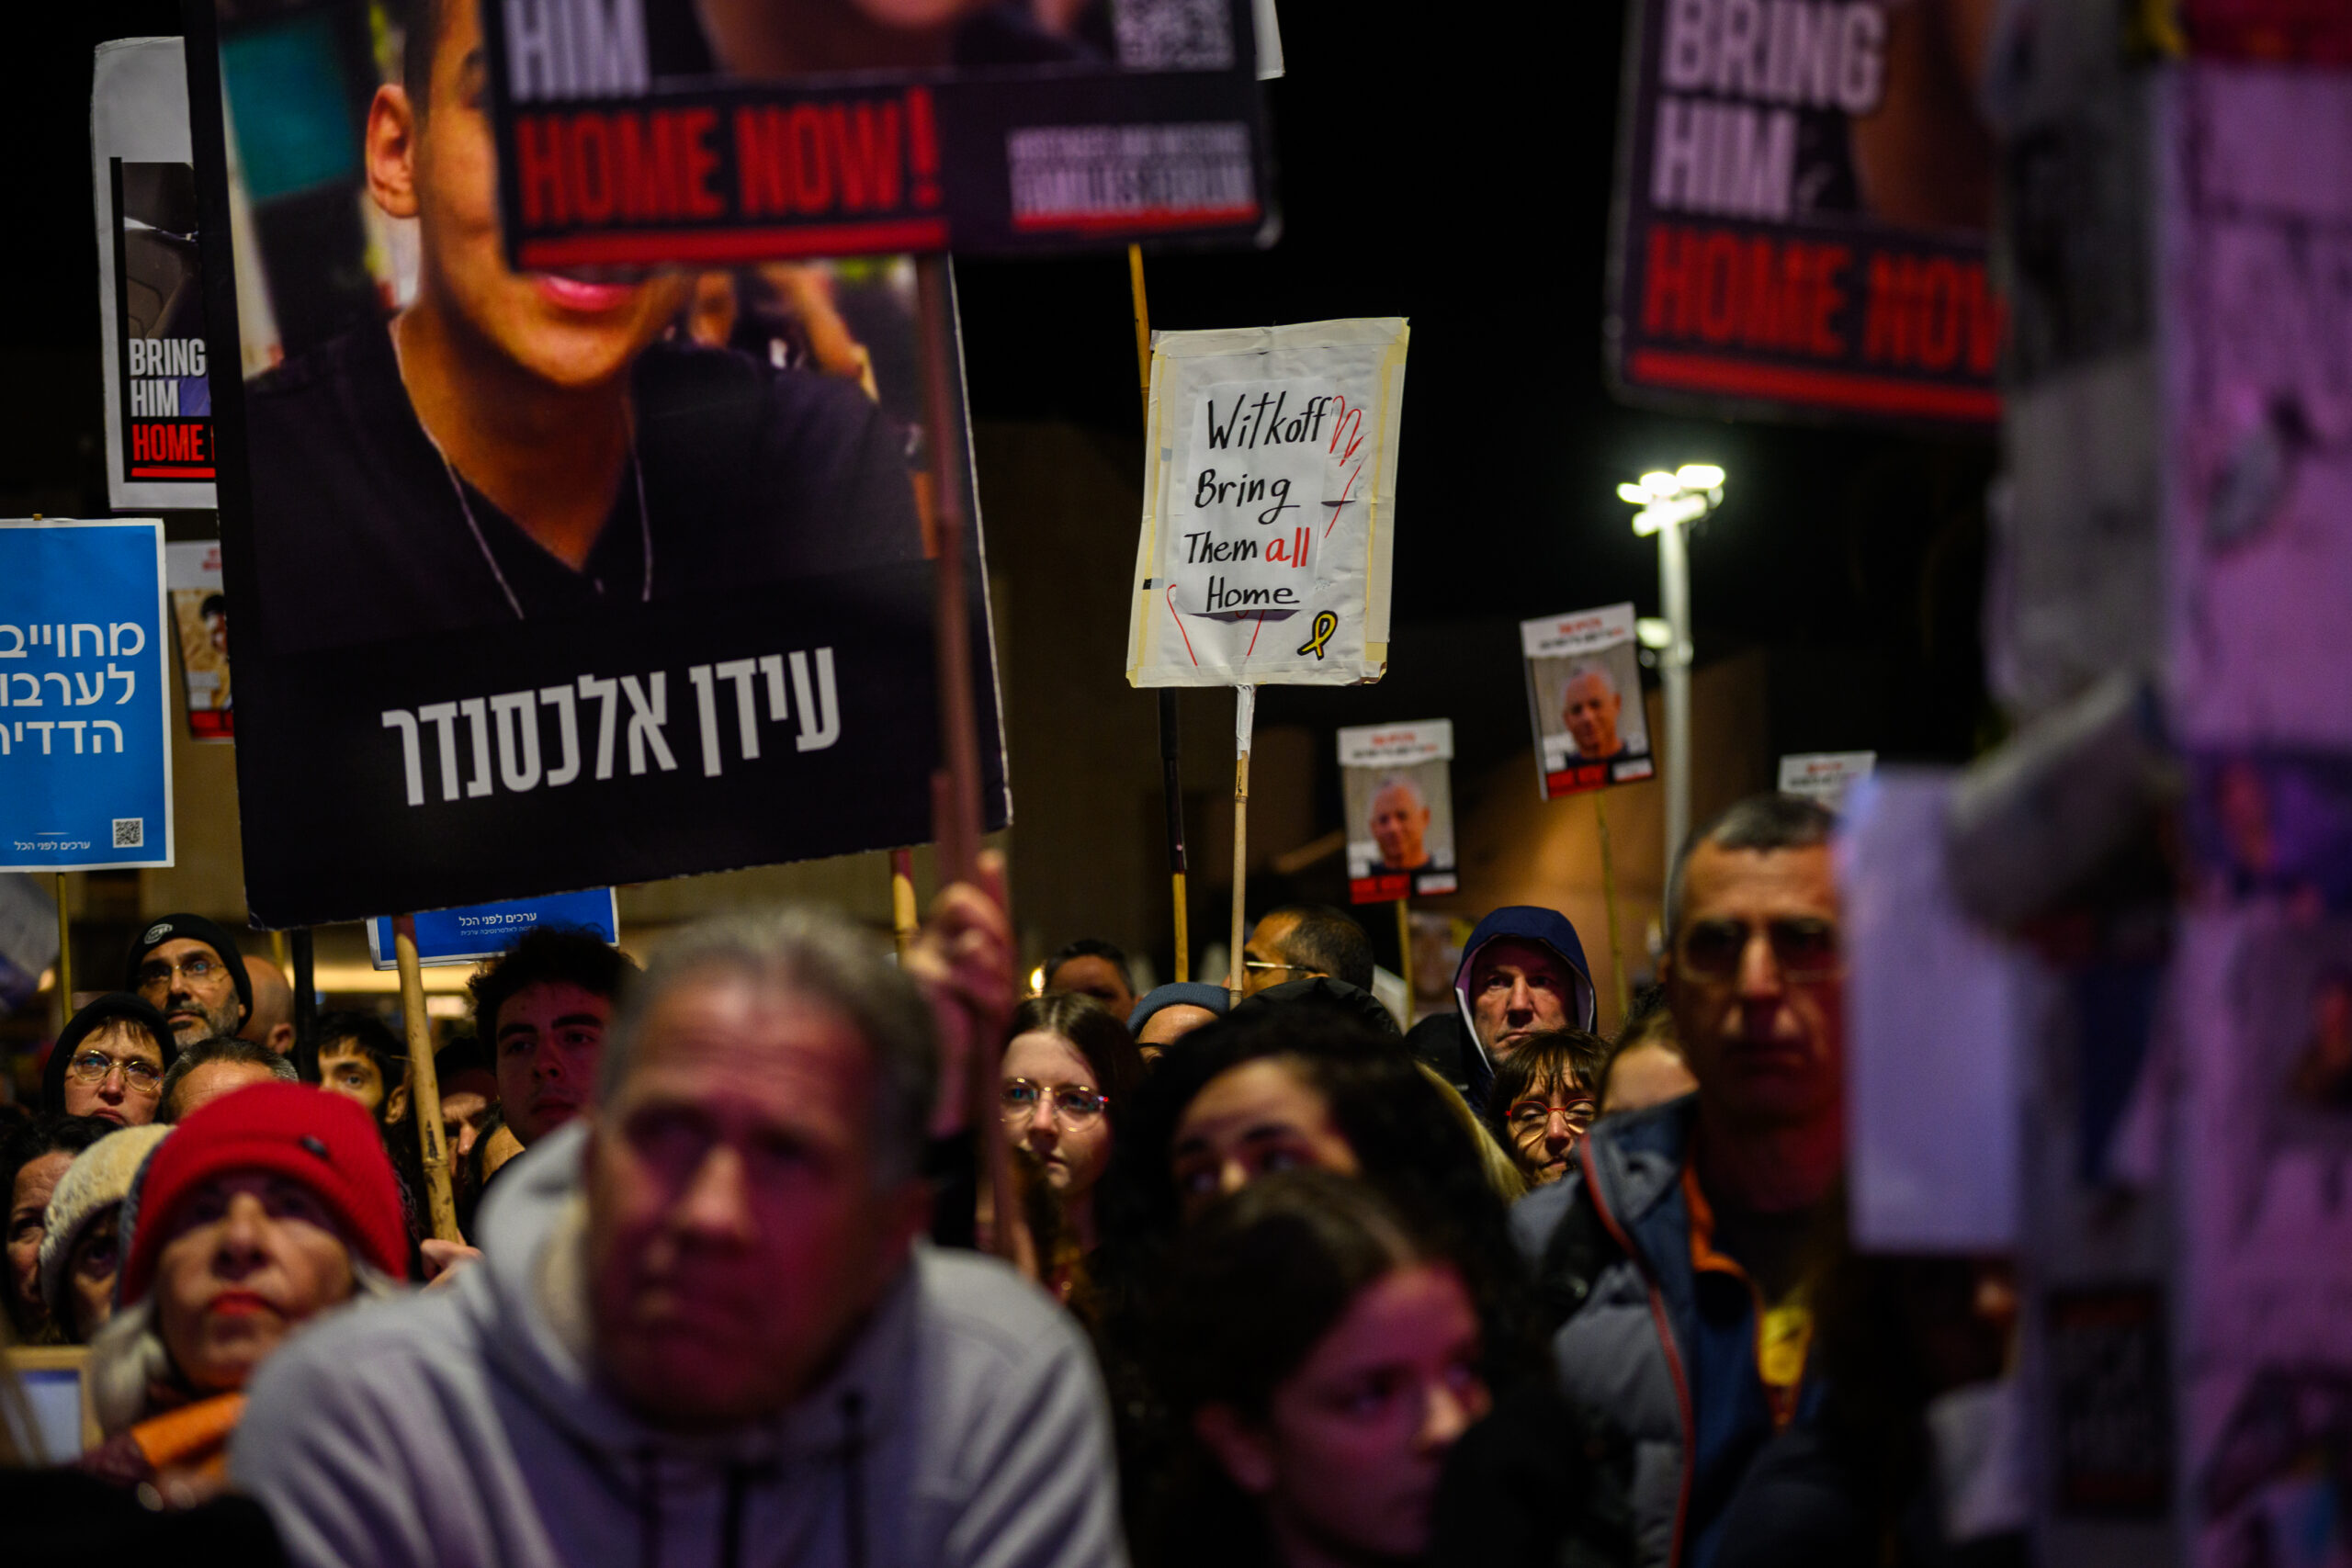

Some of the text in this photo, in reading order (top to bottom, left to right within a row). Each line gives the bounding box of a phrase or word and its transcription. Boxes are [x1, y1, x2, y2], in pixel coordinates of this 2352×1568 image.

[1660, 0, 1886, 116] BRING
[515, 108, 724, 227] HOME
[737, 85, 943, 218] NOW!
[1652, 96, 1799, 220] HIM
[1644, 224, 1851, 357] HOME
[129, 338, 207, 377] BRING
[130, 379, 179, 417] HIM
[1207, 390, 1332, 450] Witkoff
[132, 423, 205, 461] HOME
[1194, 468, 1301, 525] Bring
[1183, 527, 1310, 568] Them all
[1206, 575, 1300, 612] Home
[381, 647, 841, 807] עידן אלכסנדר
[14, 840, 91, 852] ערכים לפני הכל
[458, 912, 537, 927] ערכים לפני הכל
